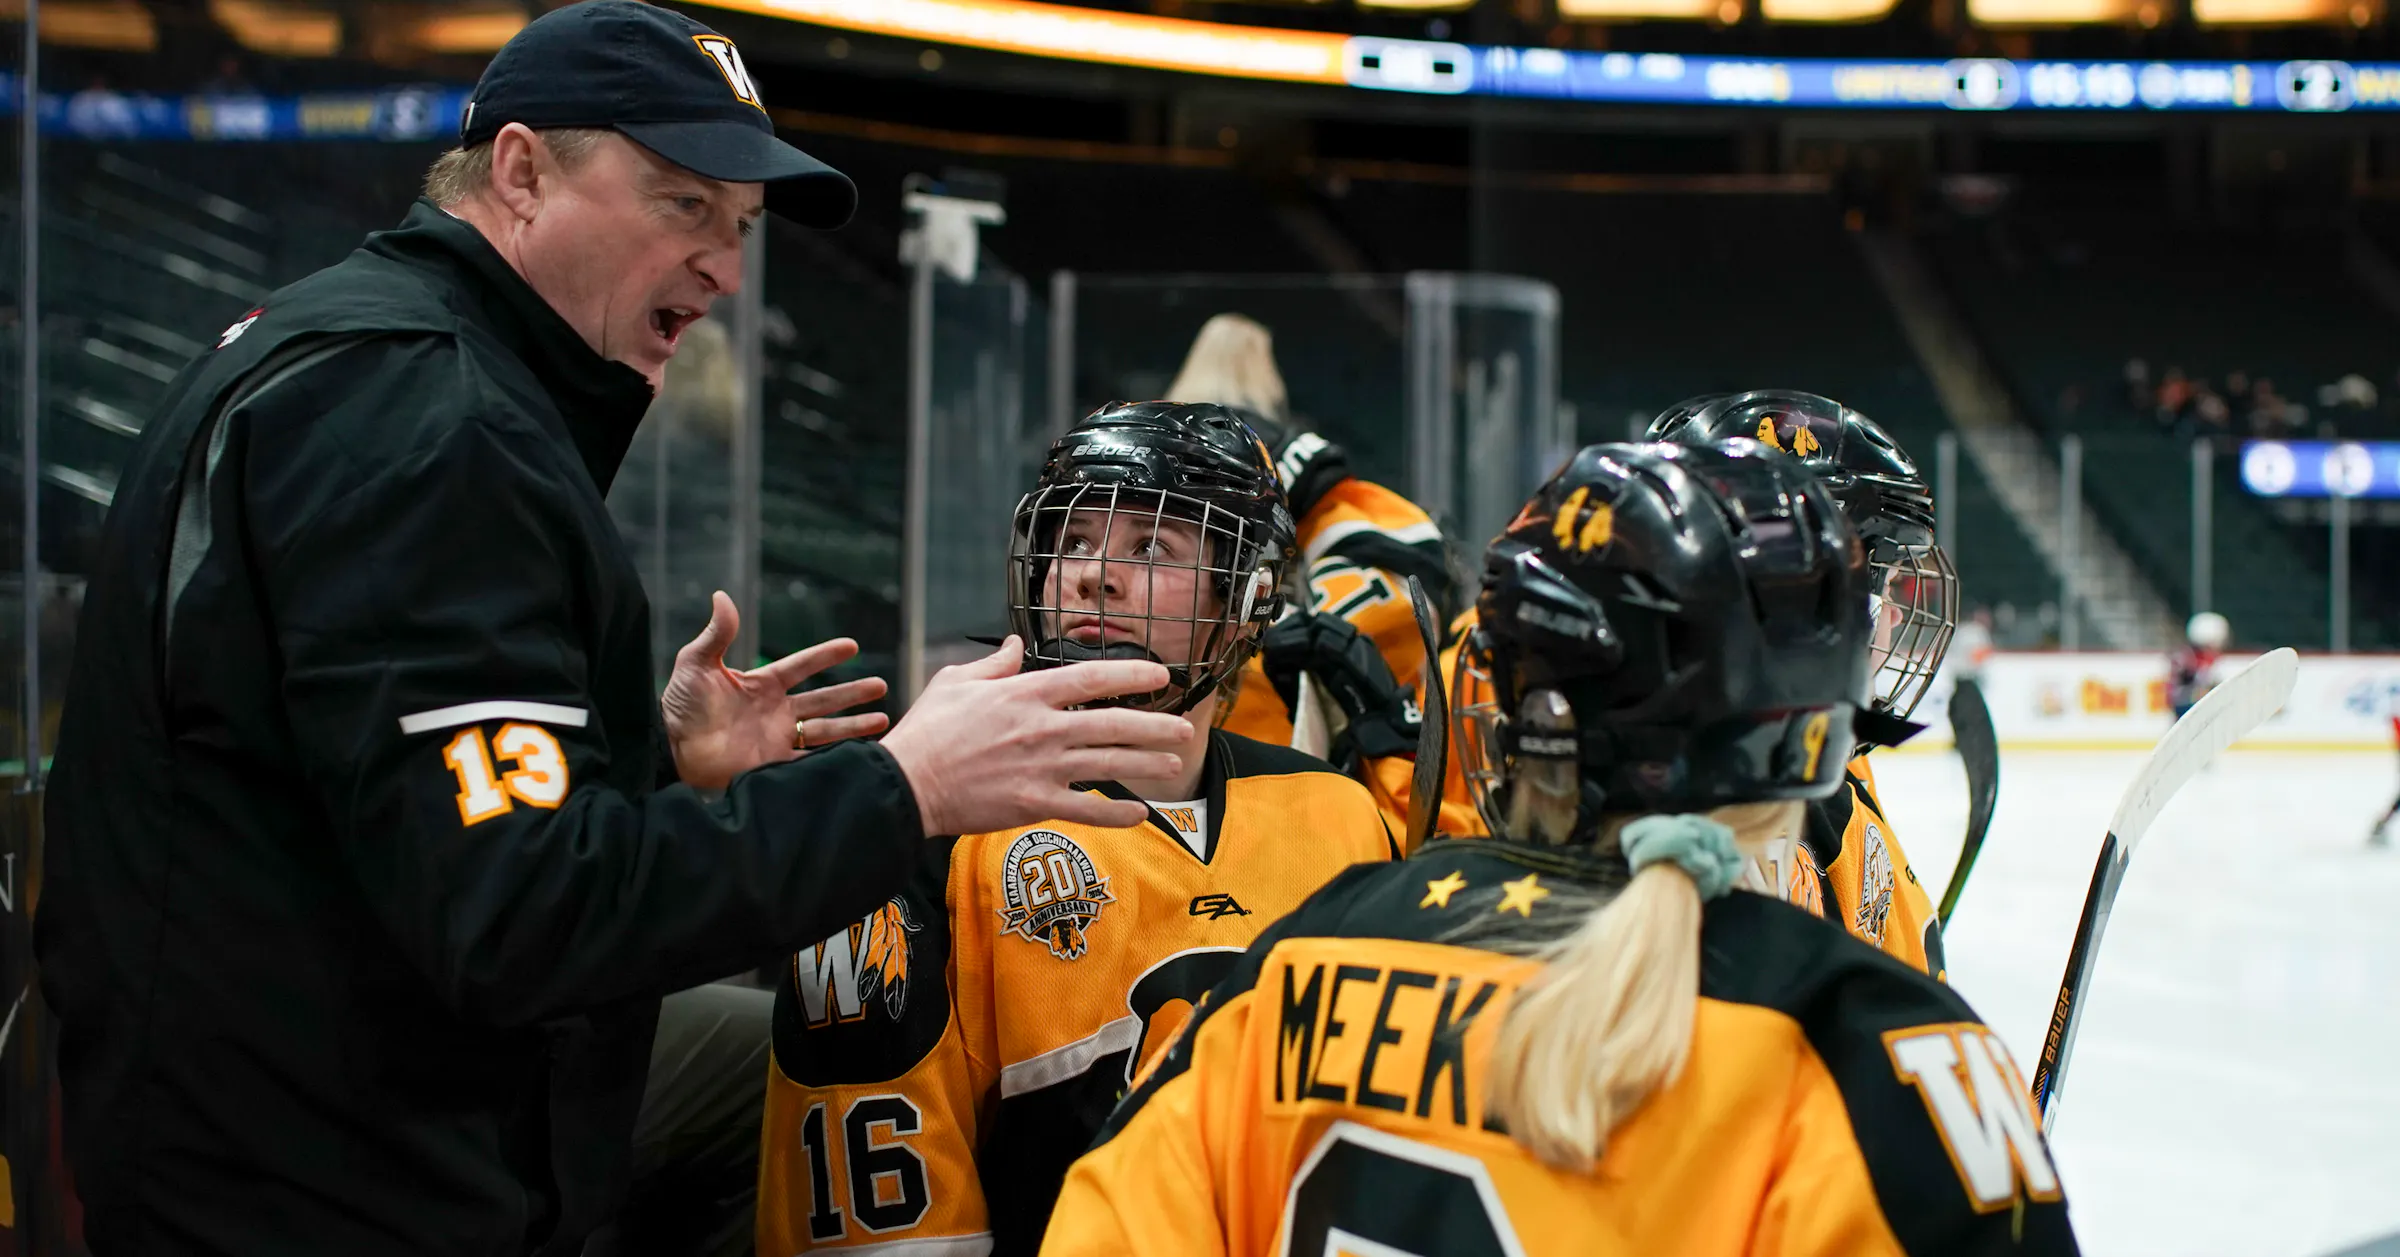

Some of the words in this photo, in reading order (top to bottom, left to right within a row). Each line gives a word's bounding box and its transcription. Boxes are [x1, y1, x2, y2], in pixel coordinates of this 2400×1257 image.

[692, 34, 766, 114] W
[1072, 443, 1151, 458] BAUER
[442, 722, 569, 827] 13
[1156, 808, 1198, 832] W
[1030, 901, 1092, 931] ANNIVERSARY
[1189, 893, 1245, 920] GA
[794, 910, 874, 1029] W
[1275, 963, 1508, 1136] MEEK
[2045, 986, 2071, 1065] BAUER
[1879, 1021, 2061, 1214] W
[801, 1093, 932, 1243] 16
